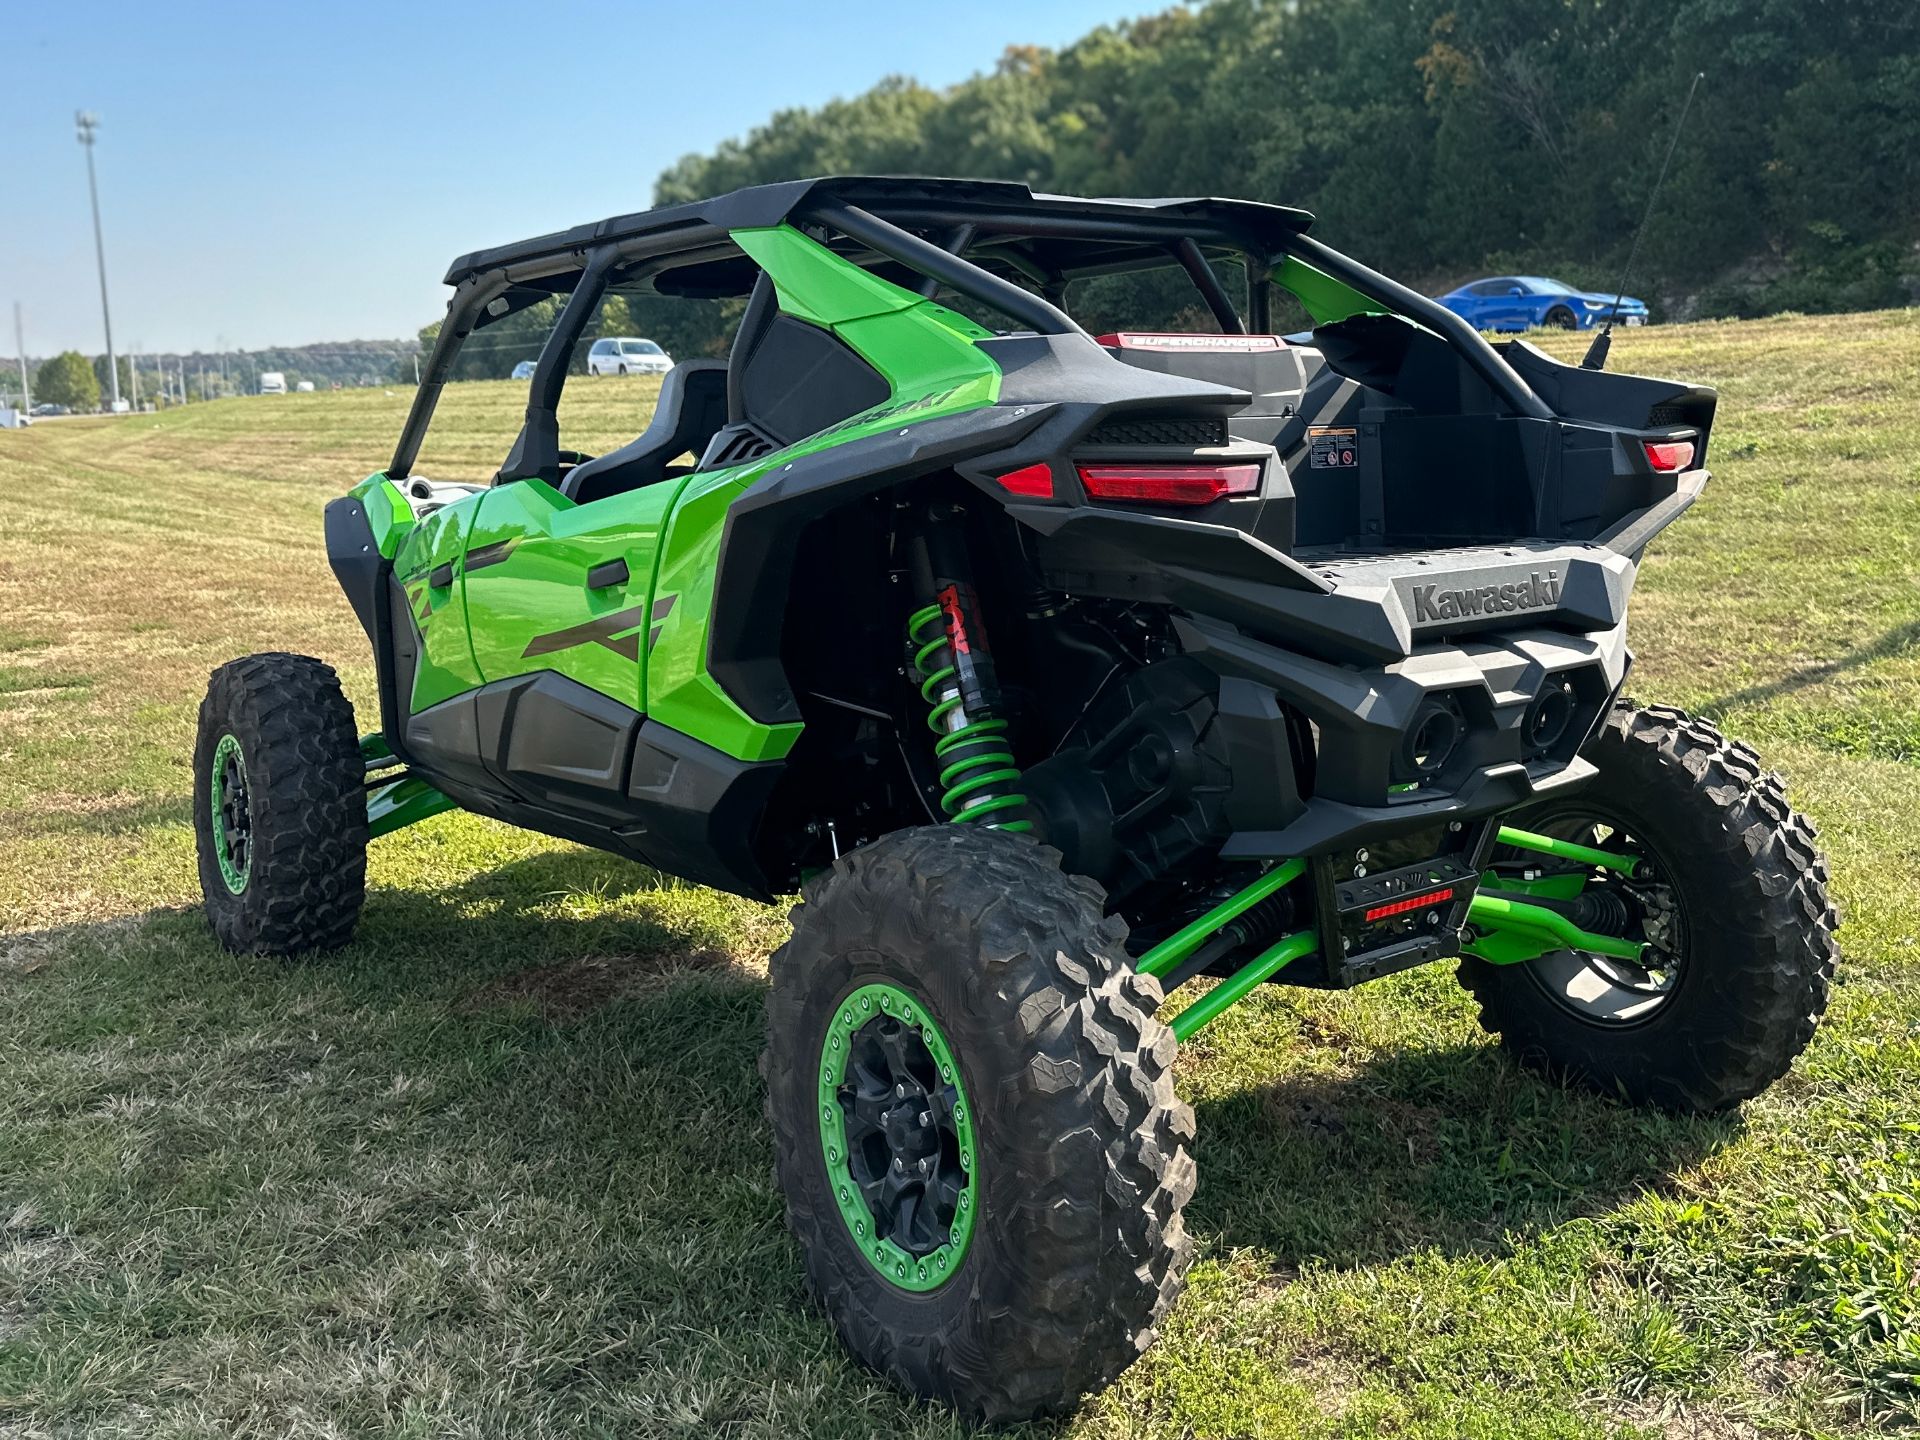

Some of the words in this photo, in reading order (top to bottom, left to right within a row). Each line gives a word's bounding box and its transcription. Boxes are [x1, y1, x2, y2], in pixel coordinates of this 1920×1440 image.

[1131, 336, 1274, 347] SUPERCHARGED
[786, 384, 963, 451] wasaki
[937, 583, 970, 657] FOX
[1413, 570, 1560, 622] Kawasaki
